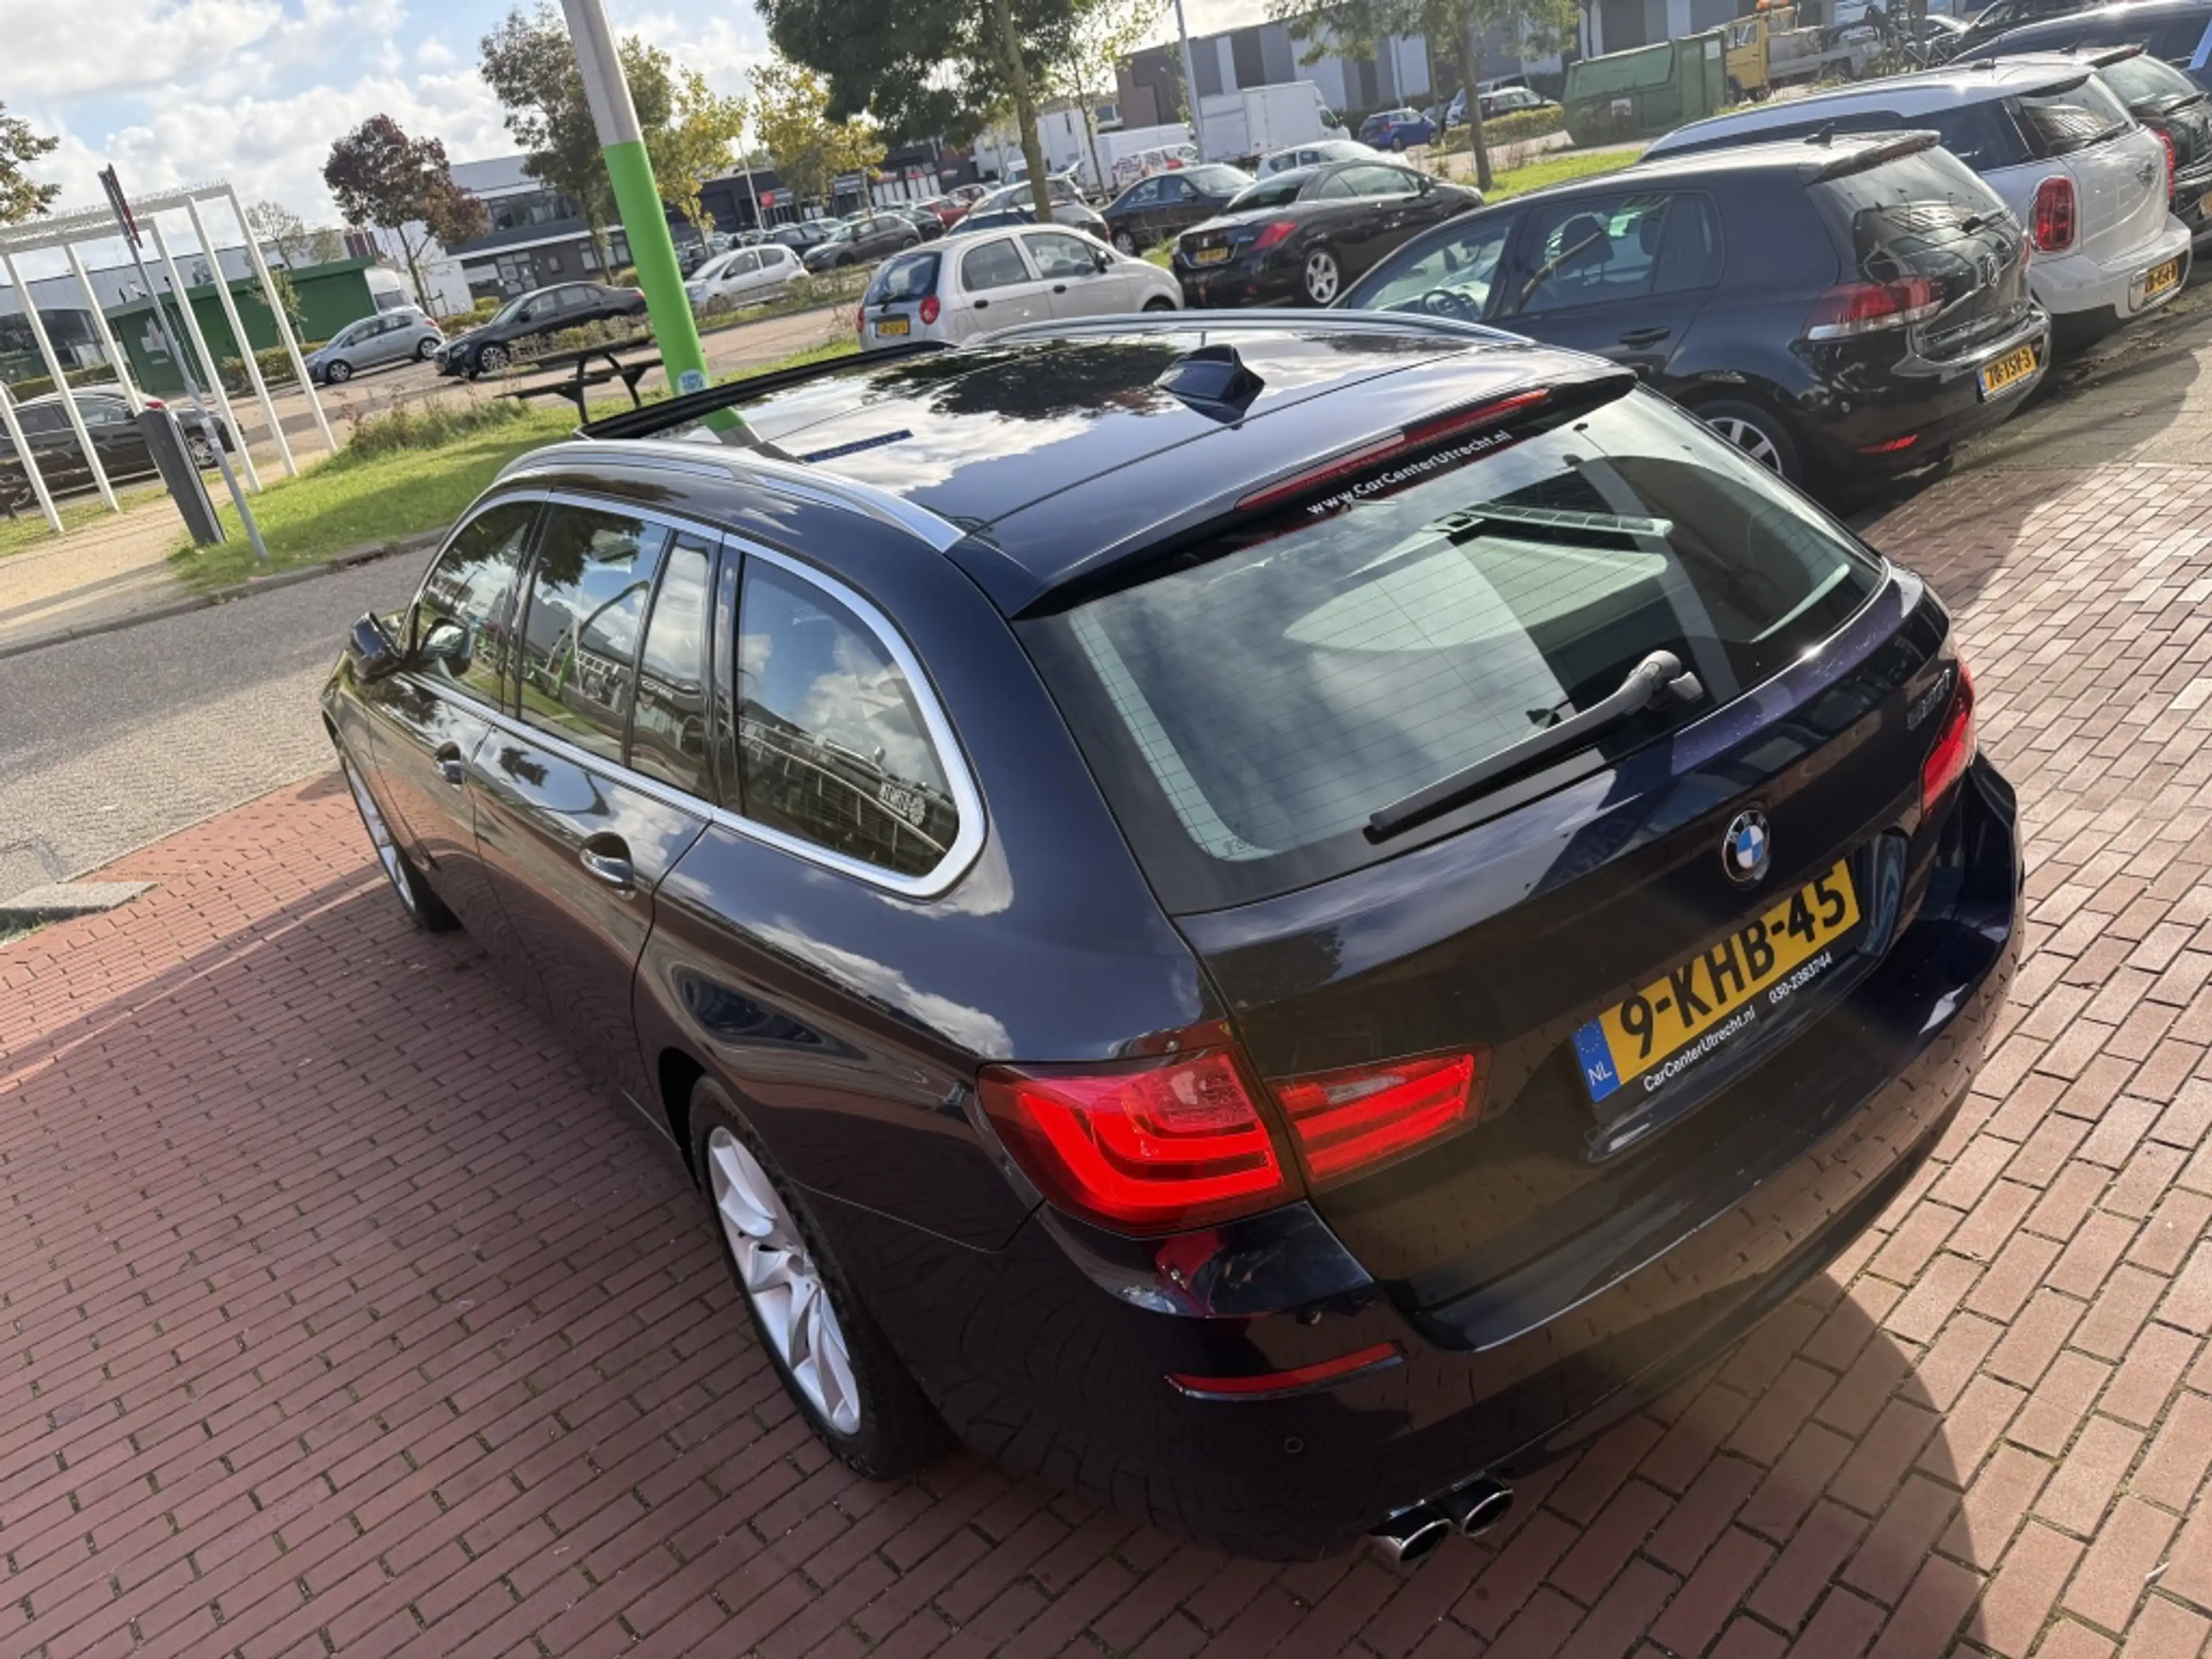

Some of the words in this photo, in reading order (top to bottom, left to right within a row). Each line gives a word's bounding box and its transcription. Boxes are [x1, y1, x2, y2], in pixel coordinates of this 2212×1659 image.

[1306, 429, 1513, 514] www.CarCenterUtrecht.nl
[1588, 1060, 1612, 1086] NL
[1620, 868, 1846, 1059] 9-KHB-45
[1643, 1004, 1756, 1092] CarCenterUtrecht.nl
